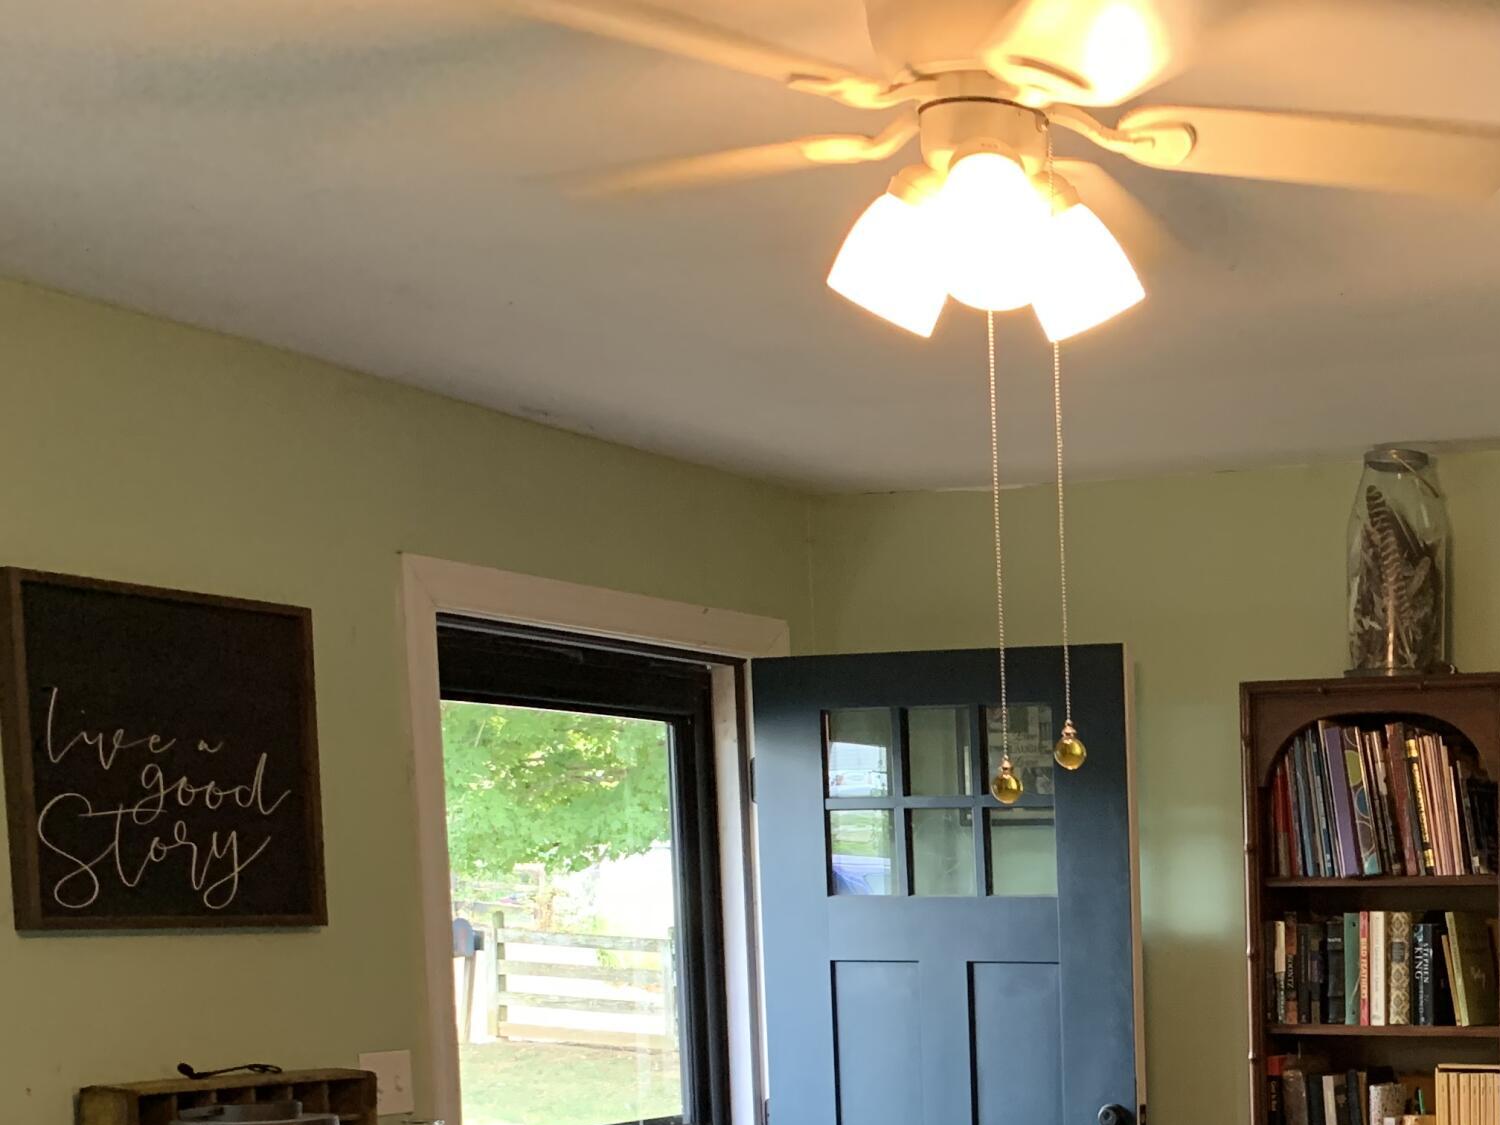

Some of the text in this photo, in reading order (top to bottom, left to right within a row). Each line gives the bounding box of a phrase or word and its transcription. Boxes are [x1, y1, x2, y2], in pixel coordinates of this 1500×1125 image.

[198, 738, 223, 753] a
[132, 753, 291, 825] good
[38, 792, 271, 909] Story
[1414, 946, 1423, 980] KING
[1422, 942, 1431, 983] STEPHEN
